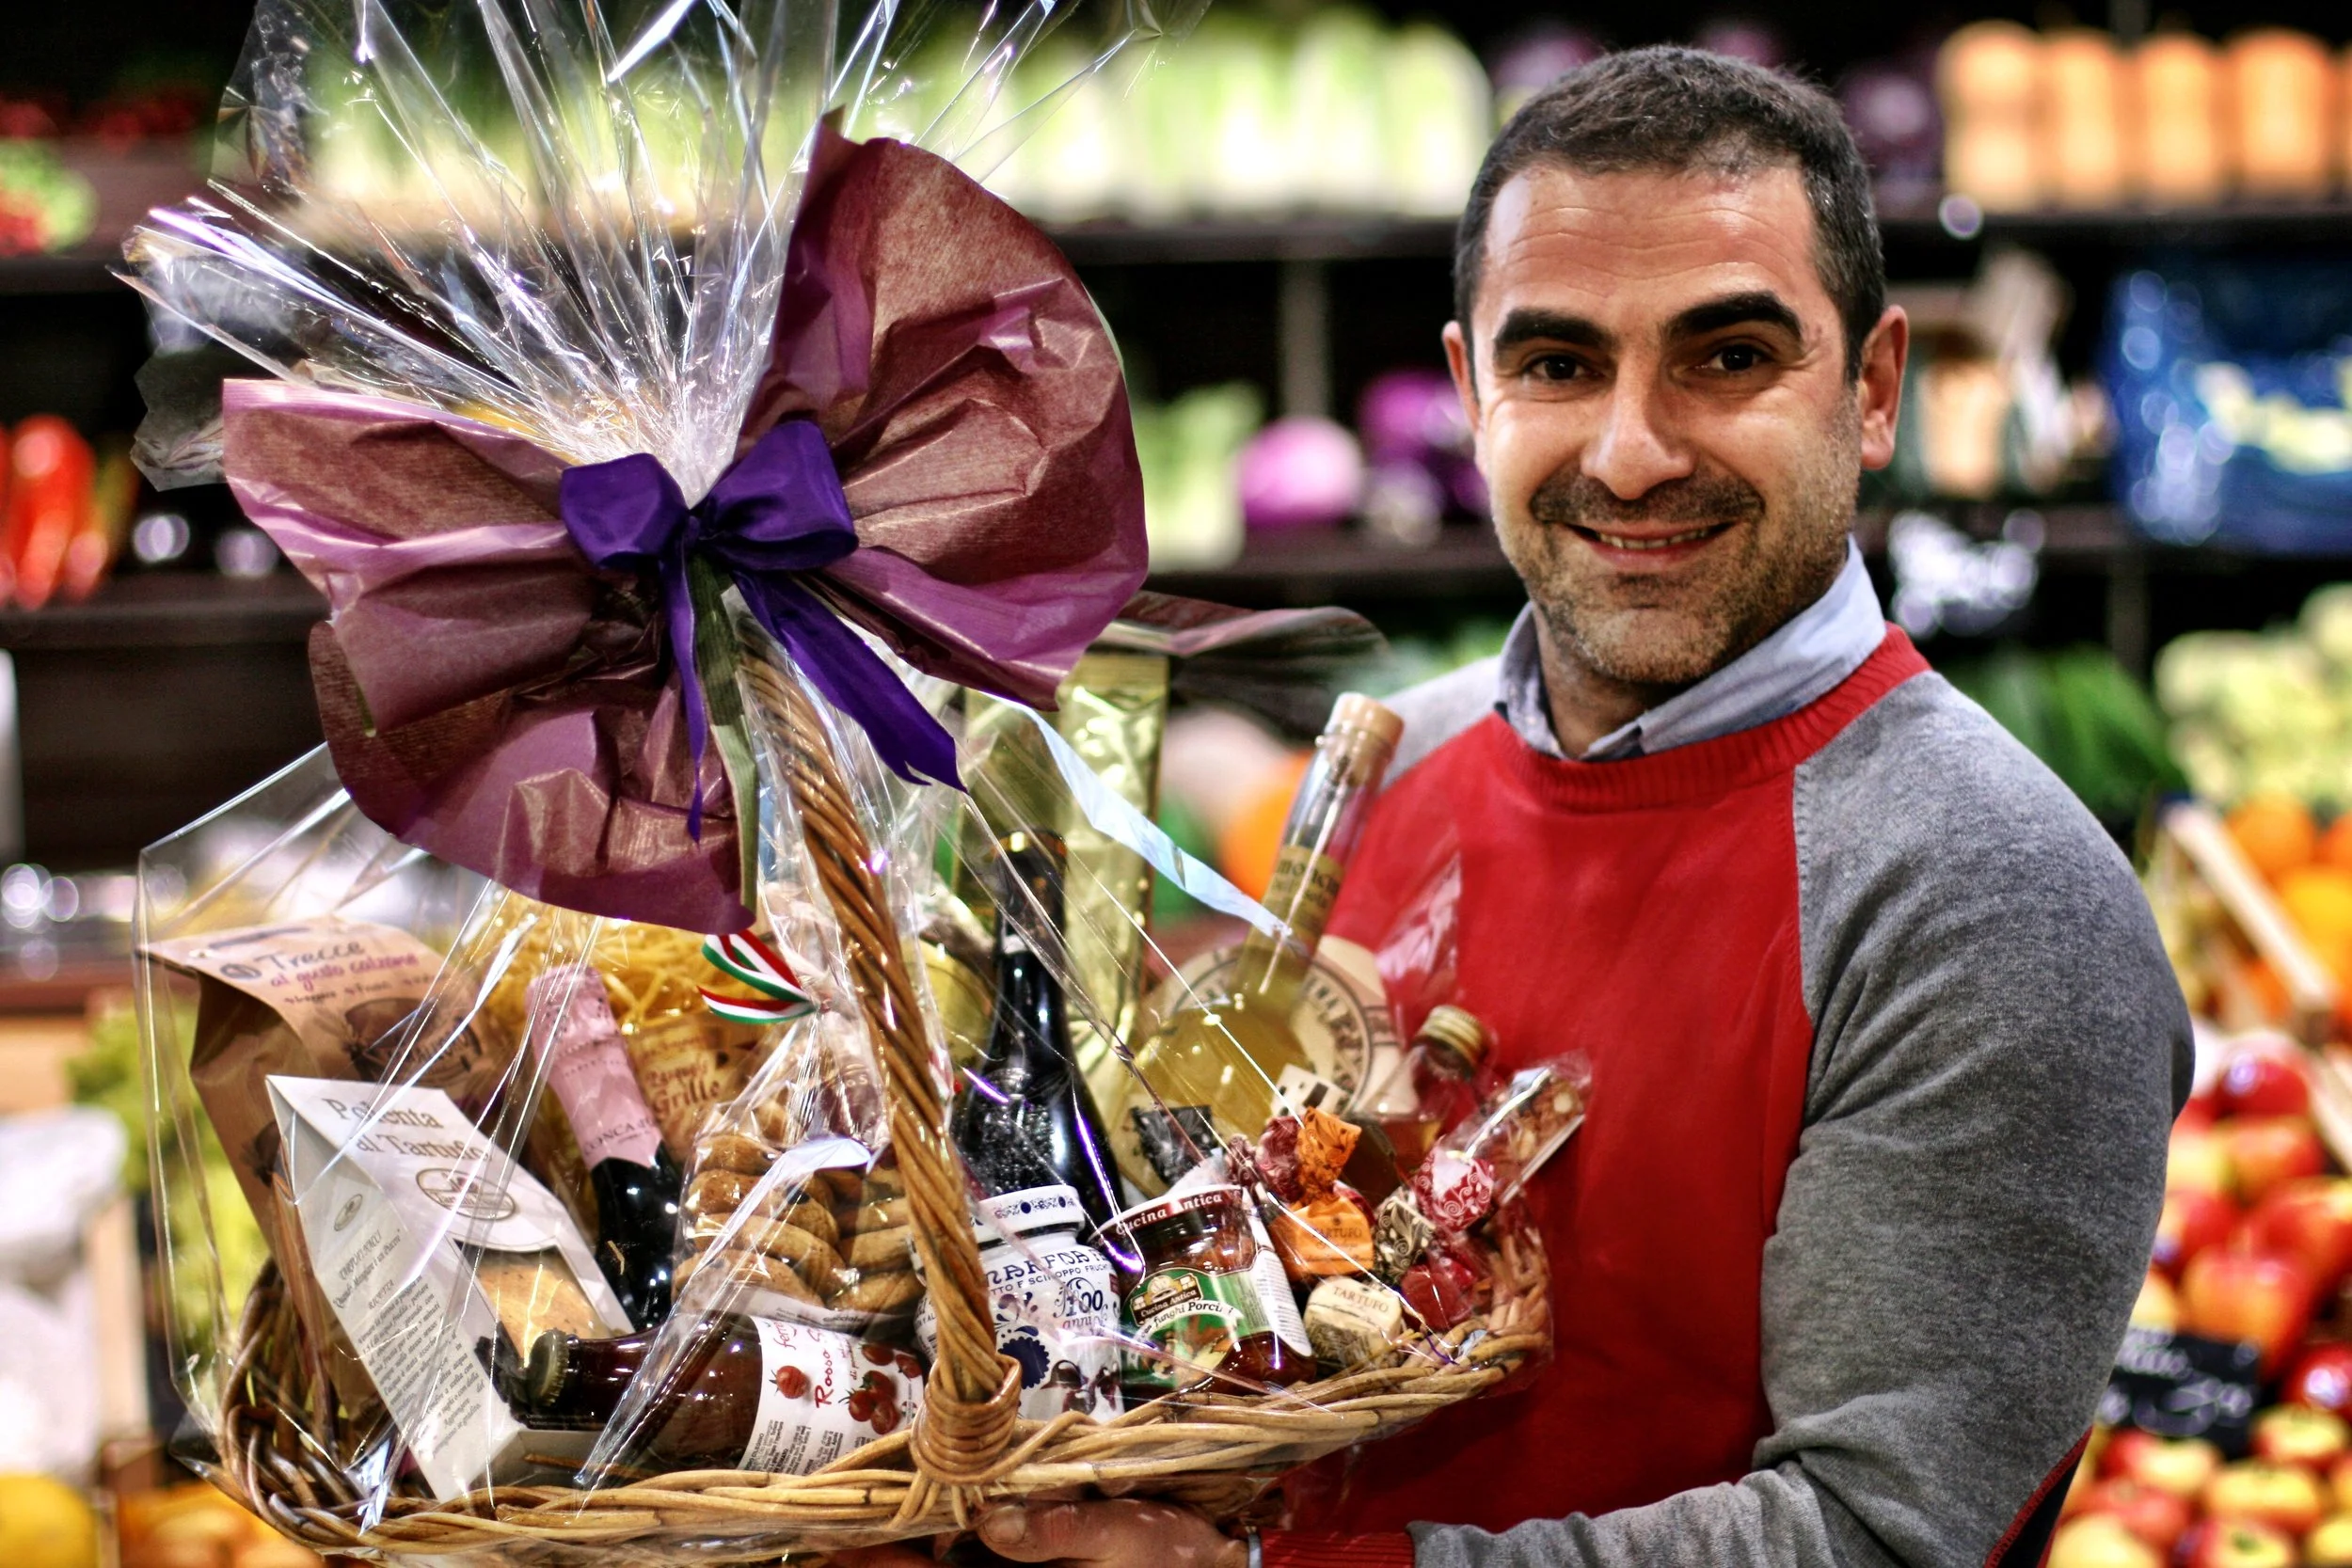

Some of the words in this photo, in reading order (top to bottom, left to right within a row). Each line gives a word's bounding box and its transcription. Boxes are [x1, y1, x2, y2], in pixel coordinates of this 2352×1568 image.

[254, 942, 365, 969] Trecce
[270, 974, 289, 987] al
[296, 963, 344, 991] gusto
[356, 1133, 384, 1153] al
[582, 1121, 636, 1154] CONCA
[1116, 1208, 1168, 1235] Cucina
[1173, 1193, 1222, 1212] Antica
[1140, 1301, 1168, 1317] Cucina
[1169, 1290, 1198, 1306] Antica
[1333, 1286, 1390, 1313] TARTUFO
[1153, 1305, 1185, 1327] funghi
[1188, 1301, 1234, 1315] Porcii
[815, 1349, 834, 1408] Rosso
